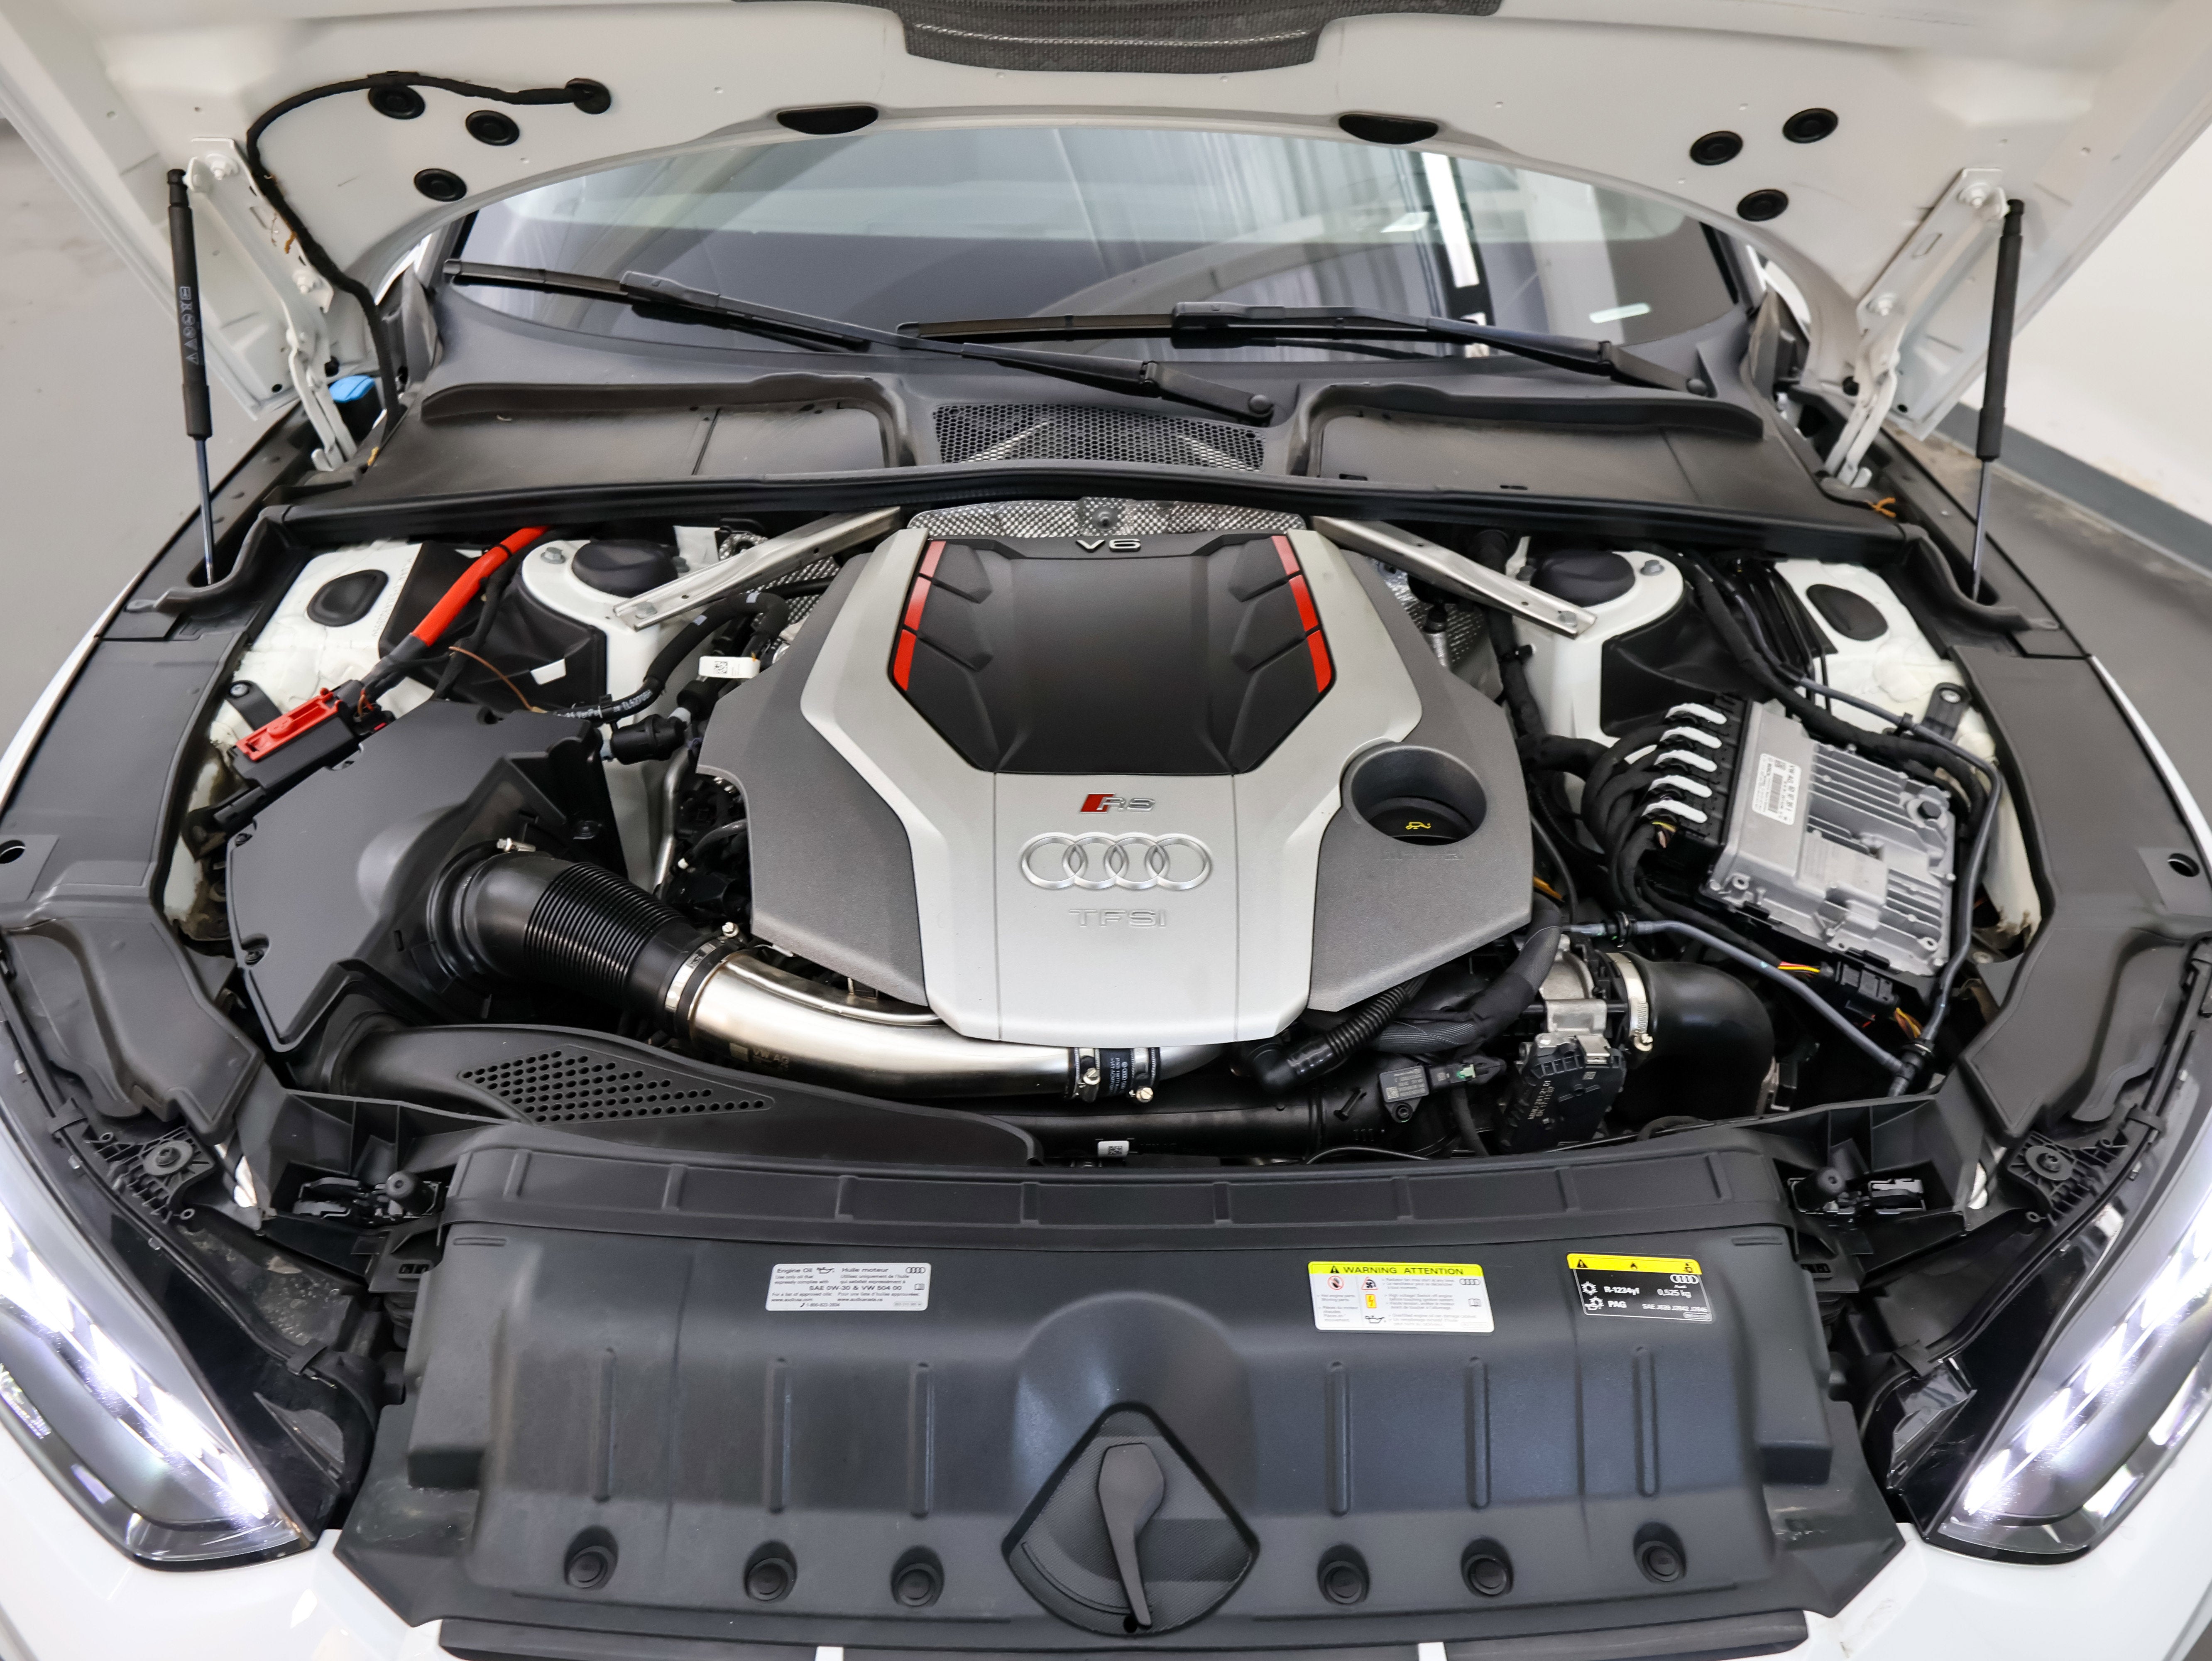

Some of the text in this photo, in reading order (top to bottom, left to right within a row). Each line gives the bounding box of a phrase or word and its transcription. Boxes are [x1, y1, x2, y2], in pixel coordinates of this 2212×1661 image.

[1075, 539, 1141, 553] V6
[1096, 796, 1155, 813] RS
[1069, 909, 1167, 928] TFSI
[1603, 1286, 1640, 1295] R-1234yf
[1680, 1290, 1692, 1298] kg
